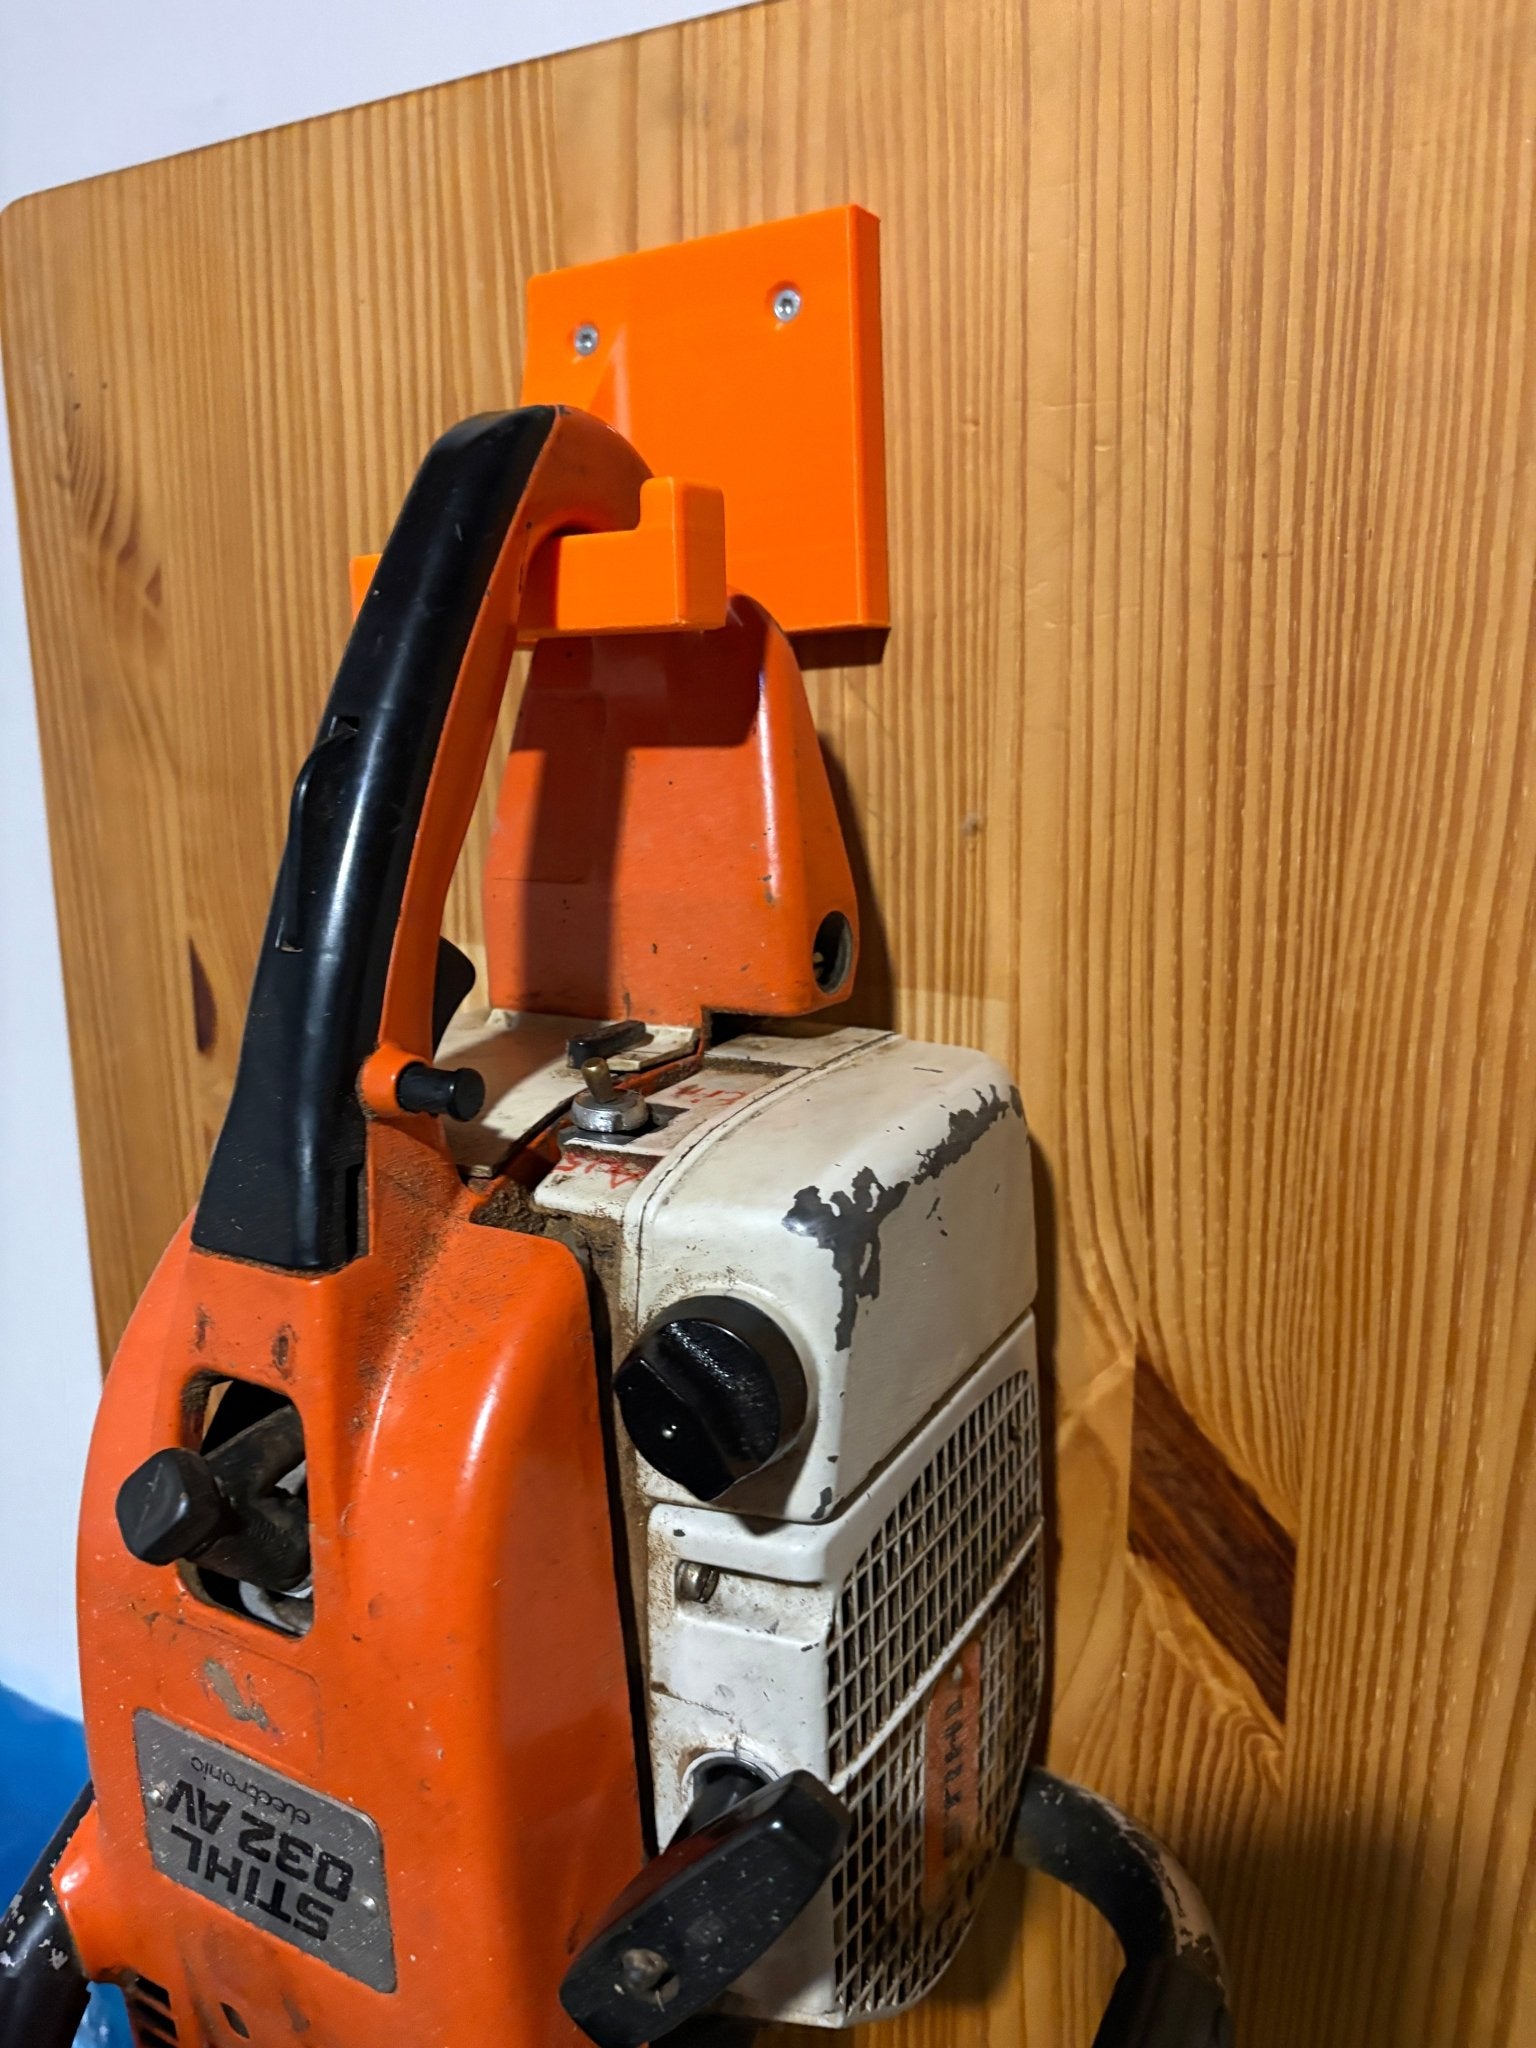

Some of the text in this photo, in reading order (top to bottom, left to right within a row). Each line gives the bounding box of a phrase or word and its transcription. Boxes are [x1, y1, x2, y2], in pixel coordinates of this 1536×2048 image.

[165, 1780, 355, 1902] 032 AV
[191, 1757, 311, 1825] electronic
[170, 1824, 335, 1941] STIHL
